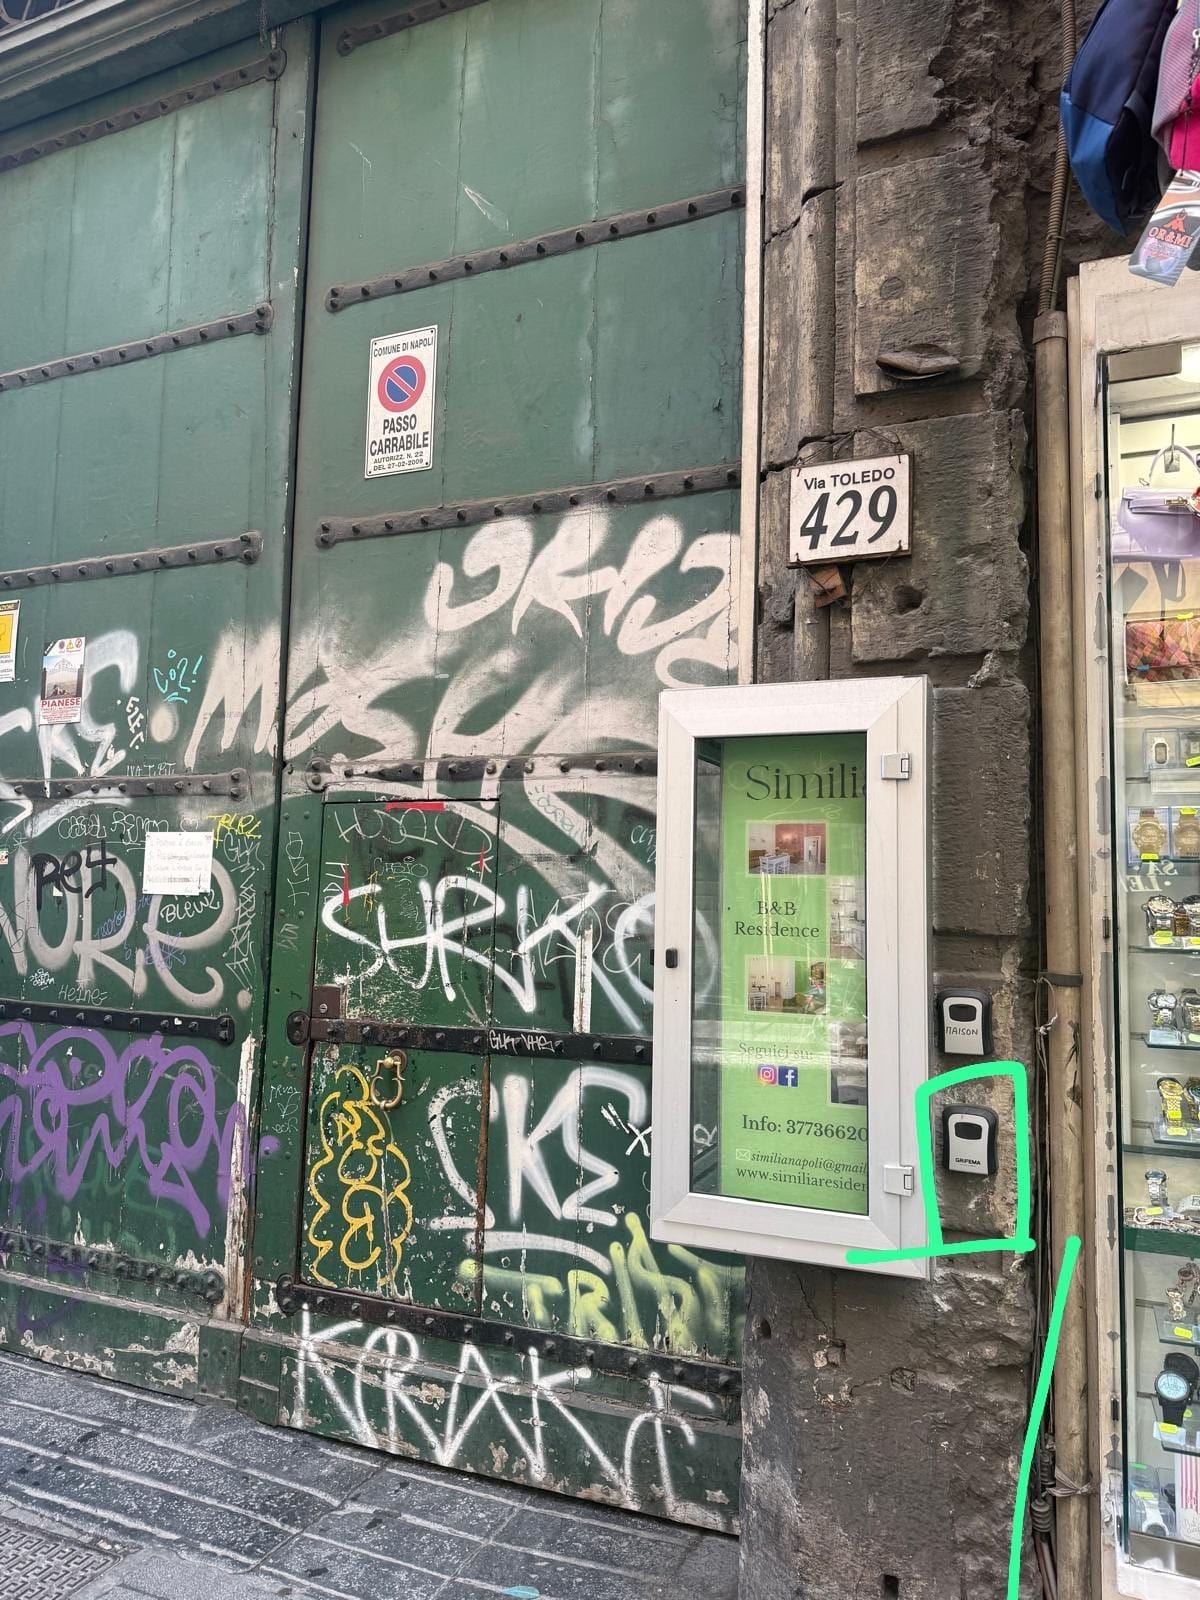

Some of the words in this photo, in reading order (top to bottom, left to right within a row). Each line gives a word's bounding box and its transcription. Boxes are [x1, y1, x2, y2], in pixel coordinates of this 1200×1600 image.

[373, 344, 400, 358] COMUNE
[402, 341, 409, 352] DI
[410, 336, 434, 350] NAPOLI
[383, 414, 417, 435] PASSO
[370, 431, 429, 457] CARRABILE
[373, 454, 405, 464] AUTORIZZ.
[373, 464, 386, 472] DEL
[804, 478, 826, 490] Via
[830, 467, 896, 487] TOLEDO
[800, 485, 898, 550] 429
[41, 698, 80, 708] PIANESE
[746, 763, 867, 800] Simili
[757, 901, 797, 916] B&B
[734, 921, 820, 938] Residence
[739, 1041, 789, 1059] Seguici
[794, 1049, 813, 1060] su:
[742, 1114, 782, 1133] Info:
